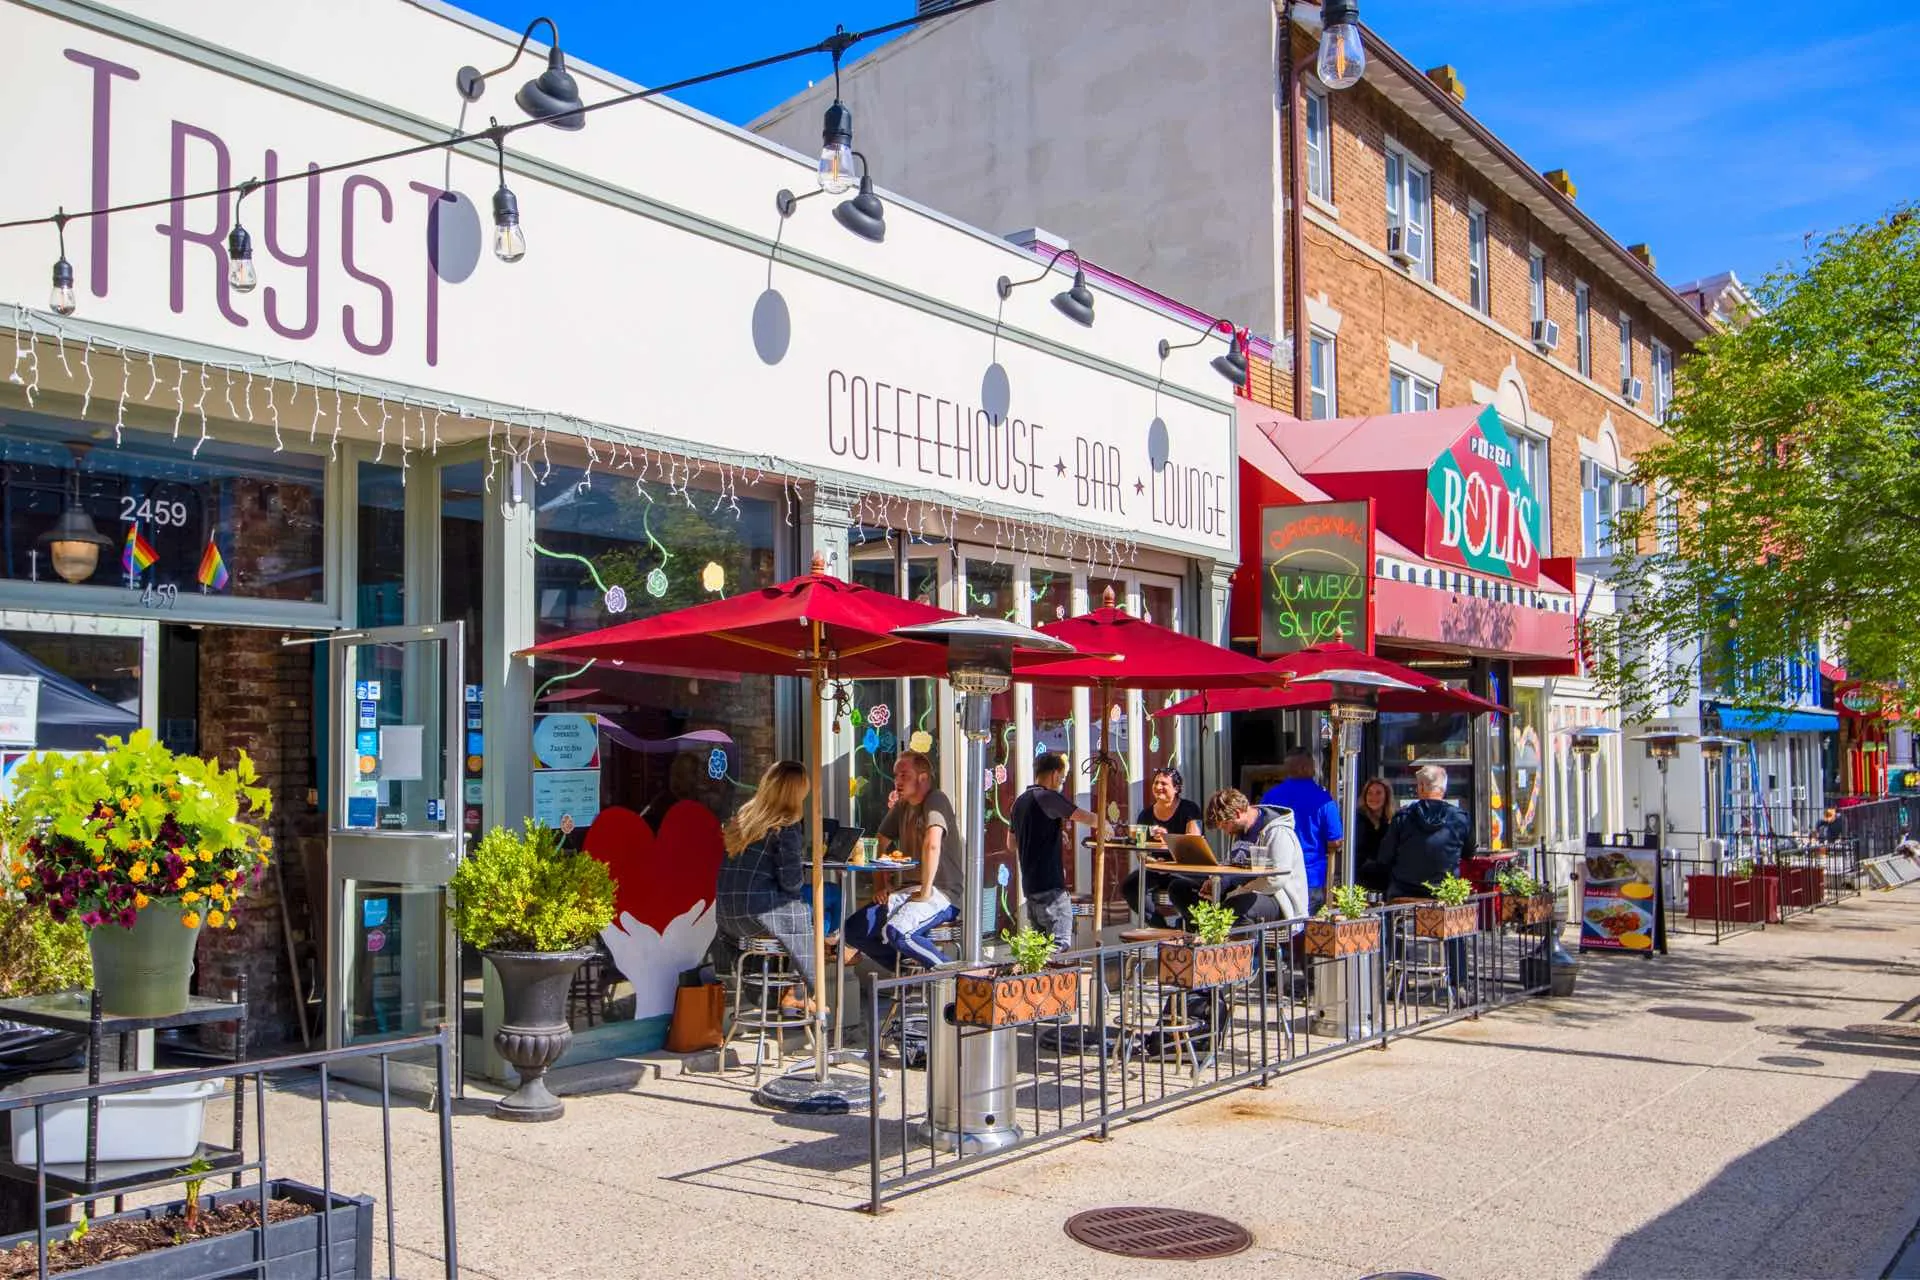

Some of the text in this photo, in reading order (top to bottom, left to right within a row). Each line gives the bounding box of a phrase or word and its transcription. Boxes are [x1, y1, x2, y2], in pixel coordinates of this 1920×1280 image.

[828, 369, 1226, 537] COFFEEHOUSE BAR LOUNGE
[1470, 436, 1512, 469] PIZZA
[120, 496, 187, 527] 2459
[1440, 467, 1531, 568] BOLI'S
[1272, 574, 1364, 601] JUMBO
[1279, 610, 1355, 637] SLICE
